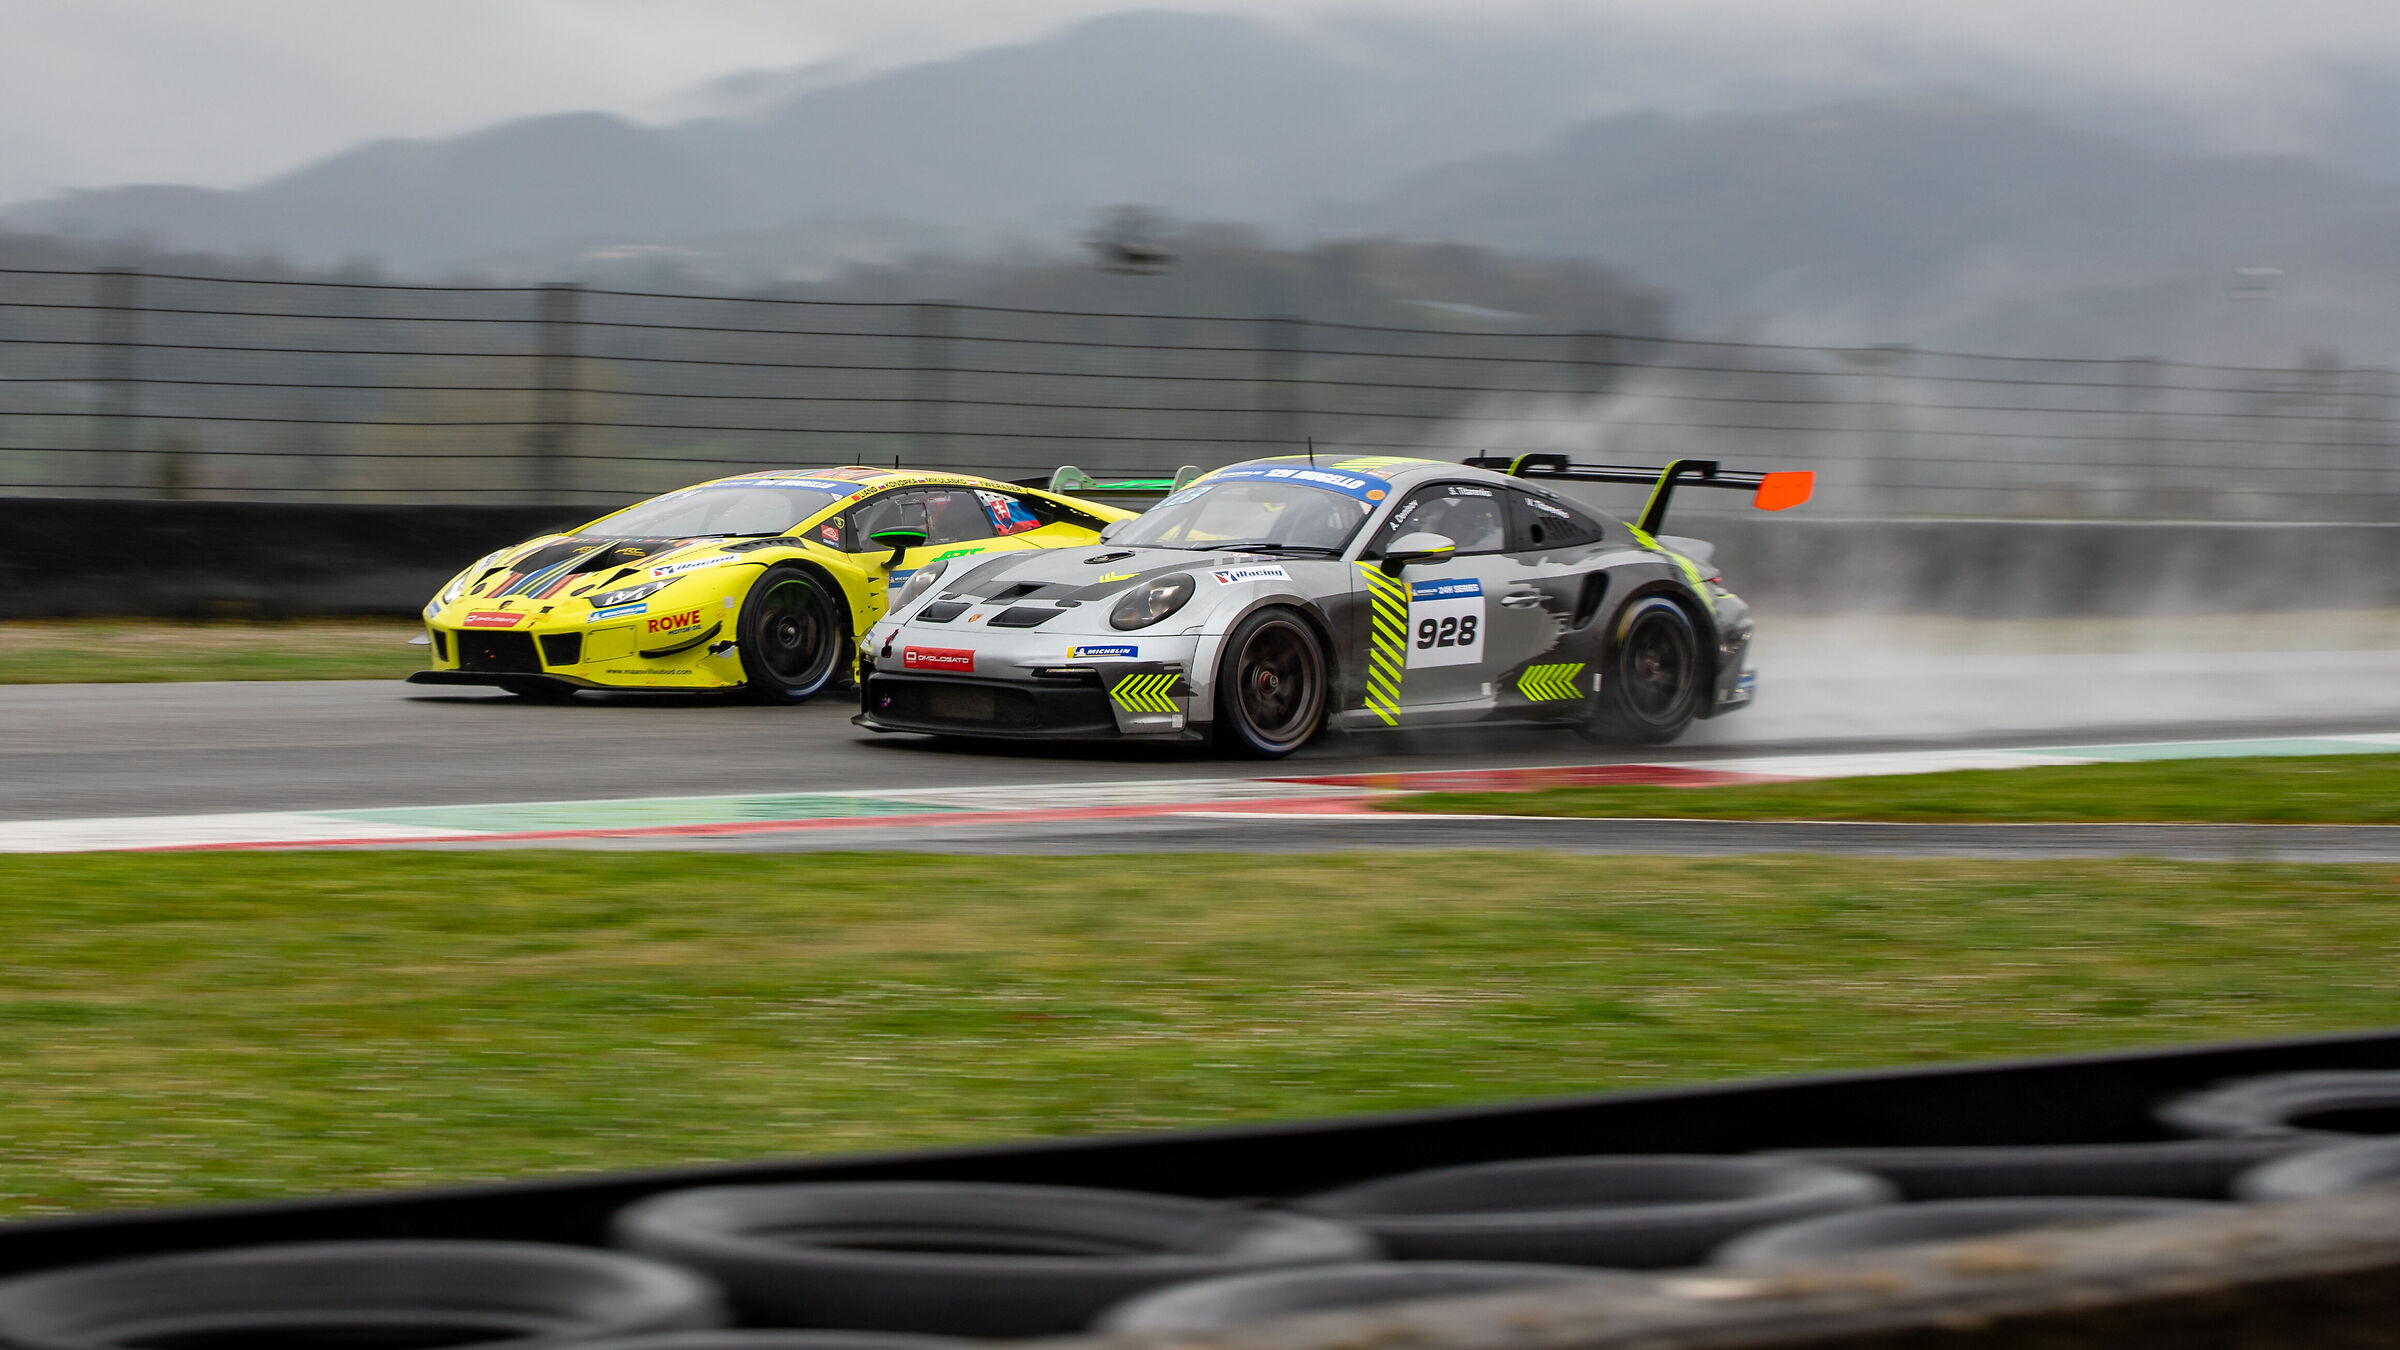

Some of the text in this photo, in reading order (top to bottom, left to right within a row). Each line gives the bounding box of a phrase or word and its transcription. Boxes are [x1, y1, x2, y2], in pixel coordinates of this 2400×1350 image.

[884, 478, 918, 489] KONOPKA
[1290, 470, 1366, 490] MUGELLO
[1236, 569, 1283, 578] iRacing
[648, 610, 701, 633] ROWE
[1416, 615, 1477, 649] 928
